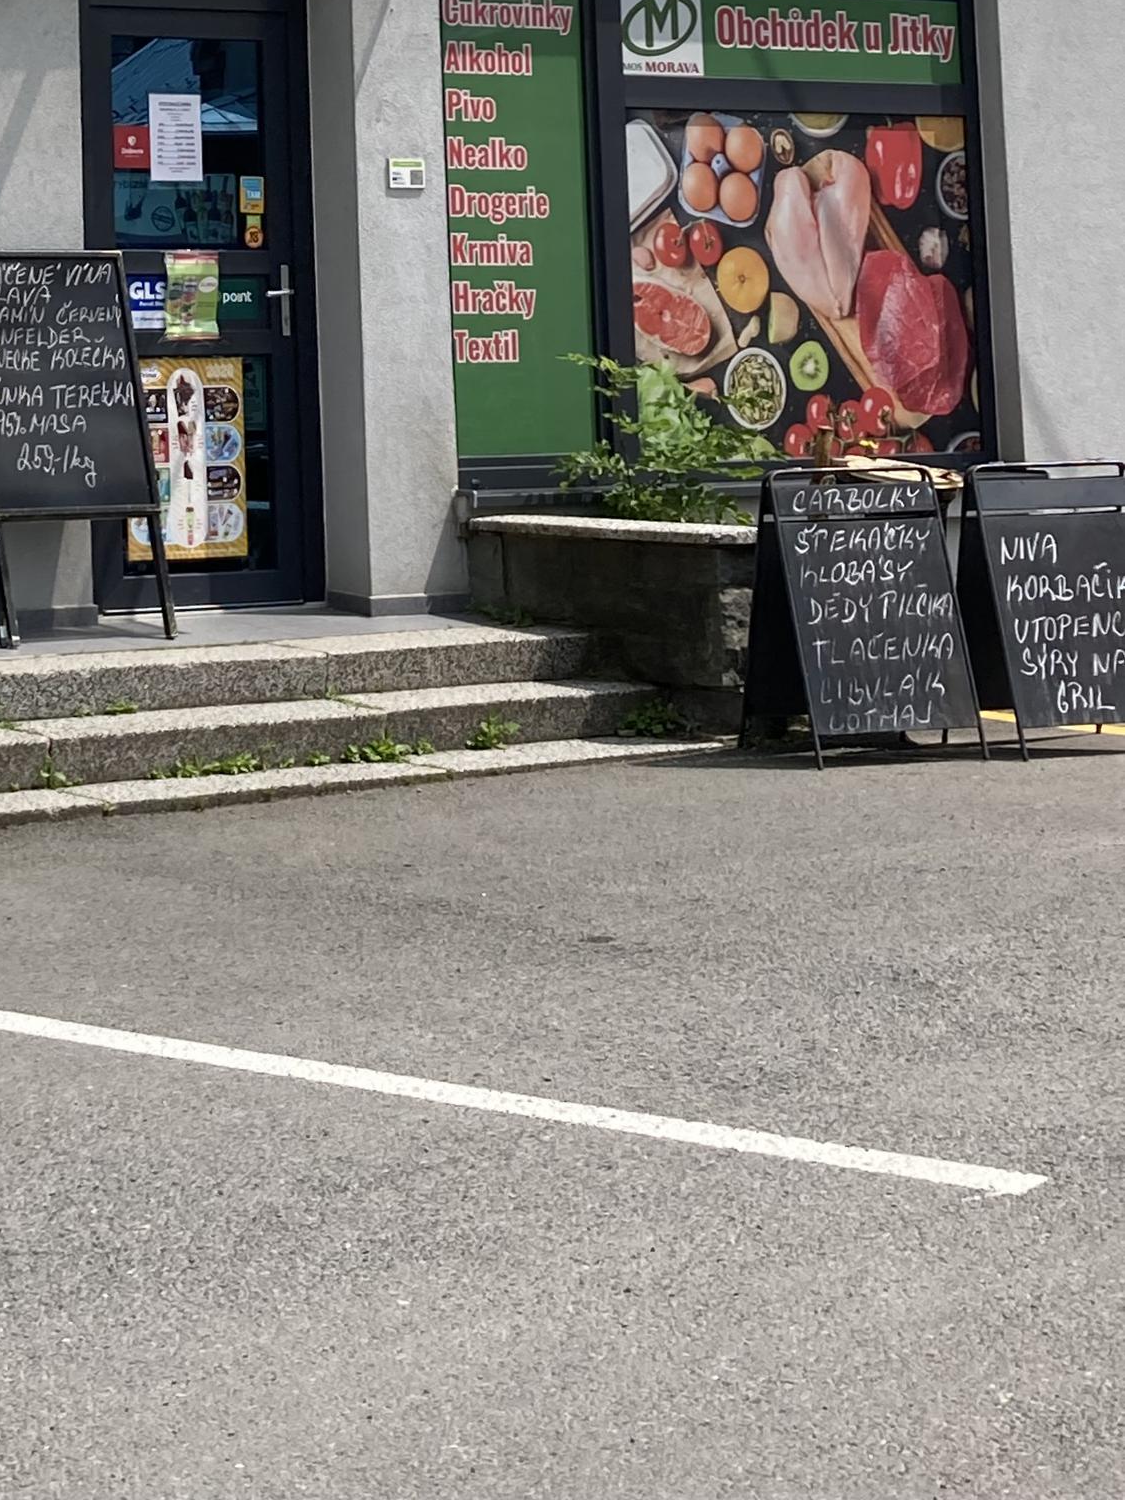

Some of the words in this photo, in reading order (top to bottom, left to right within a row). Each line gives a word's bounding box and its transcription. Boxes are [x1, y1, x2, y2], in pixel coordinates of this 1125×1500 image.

[715, 5, 857, 52] Obchůdek
[862, 21, 883, 54] u
[888, 13, 956, 62] Jitky
[444, 41, 532, 76] Alkohol
[645, 61, 700, 74] MORAVA
[446, 89, 496, 121] Pivo
[447, 137, 527, 170] Nealko
[449, 184, 549, 224] Drogerie
[451, 233, 533, 266] Krmiva
[129, 281, 166, 300] GLS
[222, 291, 252, 303] point
[452, 281, 536, 320] Hračky
[454, 329, 519, 363] Textil
[1001, 532, 1058, 565] NIVA
[1057, 680, 1116, 714] GRIL
